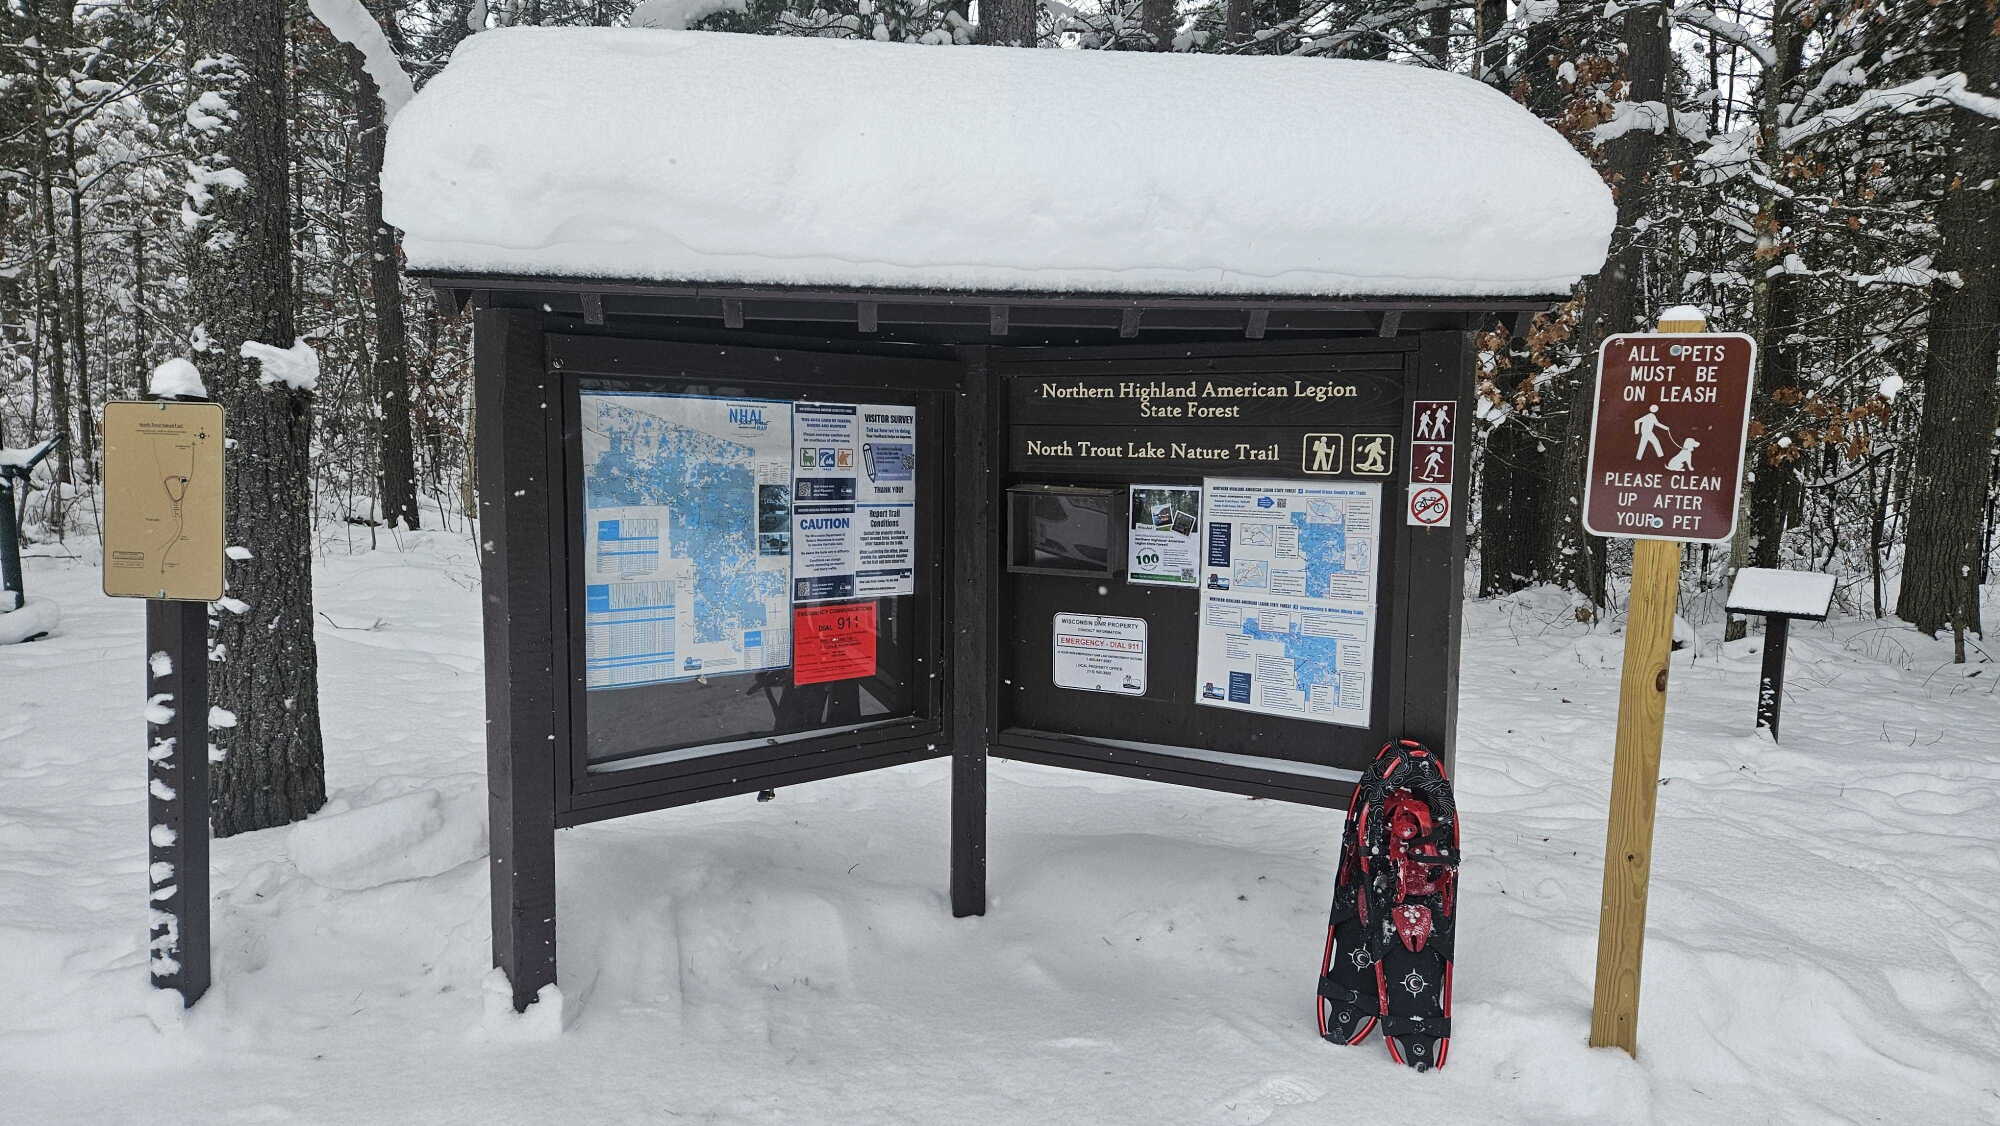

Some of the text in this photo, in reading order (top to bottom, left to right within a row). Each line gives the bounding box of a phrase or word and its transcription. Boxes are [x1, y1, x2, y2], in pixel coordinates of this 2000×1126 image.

[1628, 345, 1726, 362] ALL PETS
[1631, 366, 1718, 383] MUST BE
[1041, 380, 1357, 403] Northern Highland American Legion
[1623, 385, 1717, 403] ON LEASH
[1140, 402, 1239, 417] State Forest
[864, 413, 914, 425] VISITOR SURVEY
[1027, 441, 1279, 461] North Trout Lake Nature Trail
[1605, 472, 1722, 491] PLEASE CLEAN
[874, 486, 904, 494] THANK YOU!
[1618, 492, 1703, 510] UP AFTER
[869, 508, 901, 518] Report Trail
[800, 518, 850, 530] CAUTION
[870, 519, 899, 528] Conditions
[1672, 515, 1702, 531] PET
[1135, 553, 1160, 566] 100
[1061, 618, 1093, 626] WISCONSIN
[1107, 622, 1139, 630] PROPERTY
[1060, 637, 1105, 647] EMERGENCY
[1110, 641, 1126, 649] DIAL
